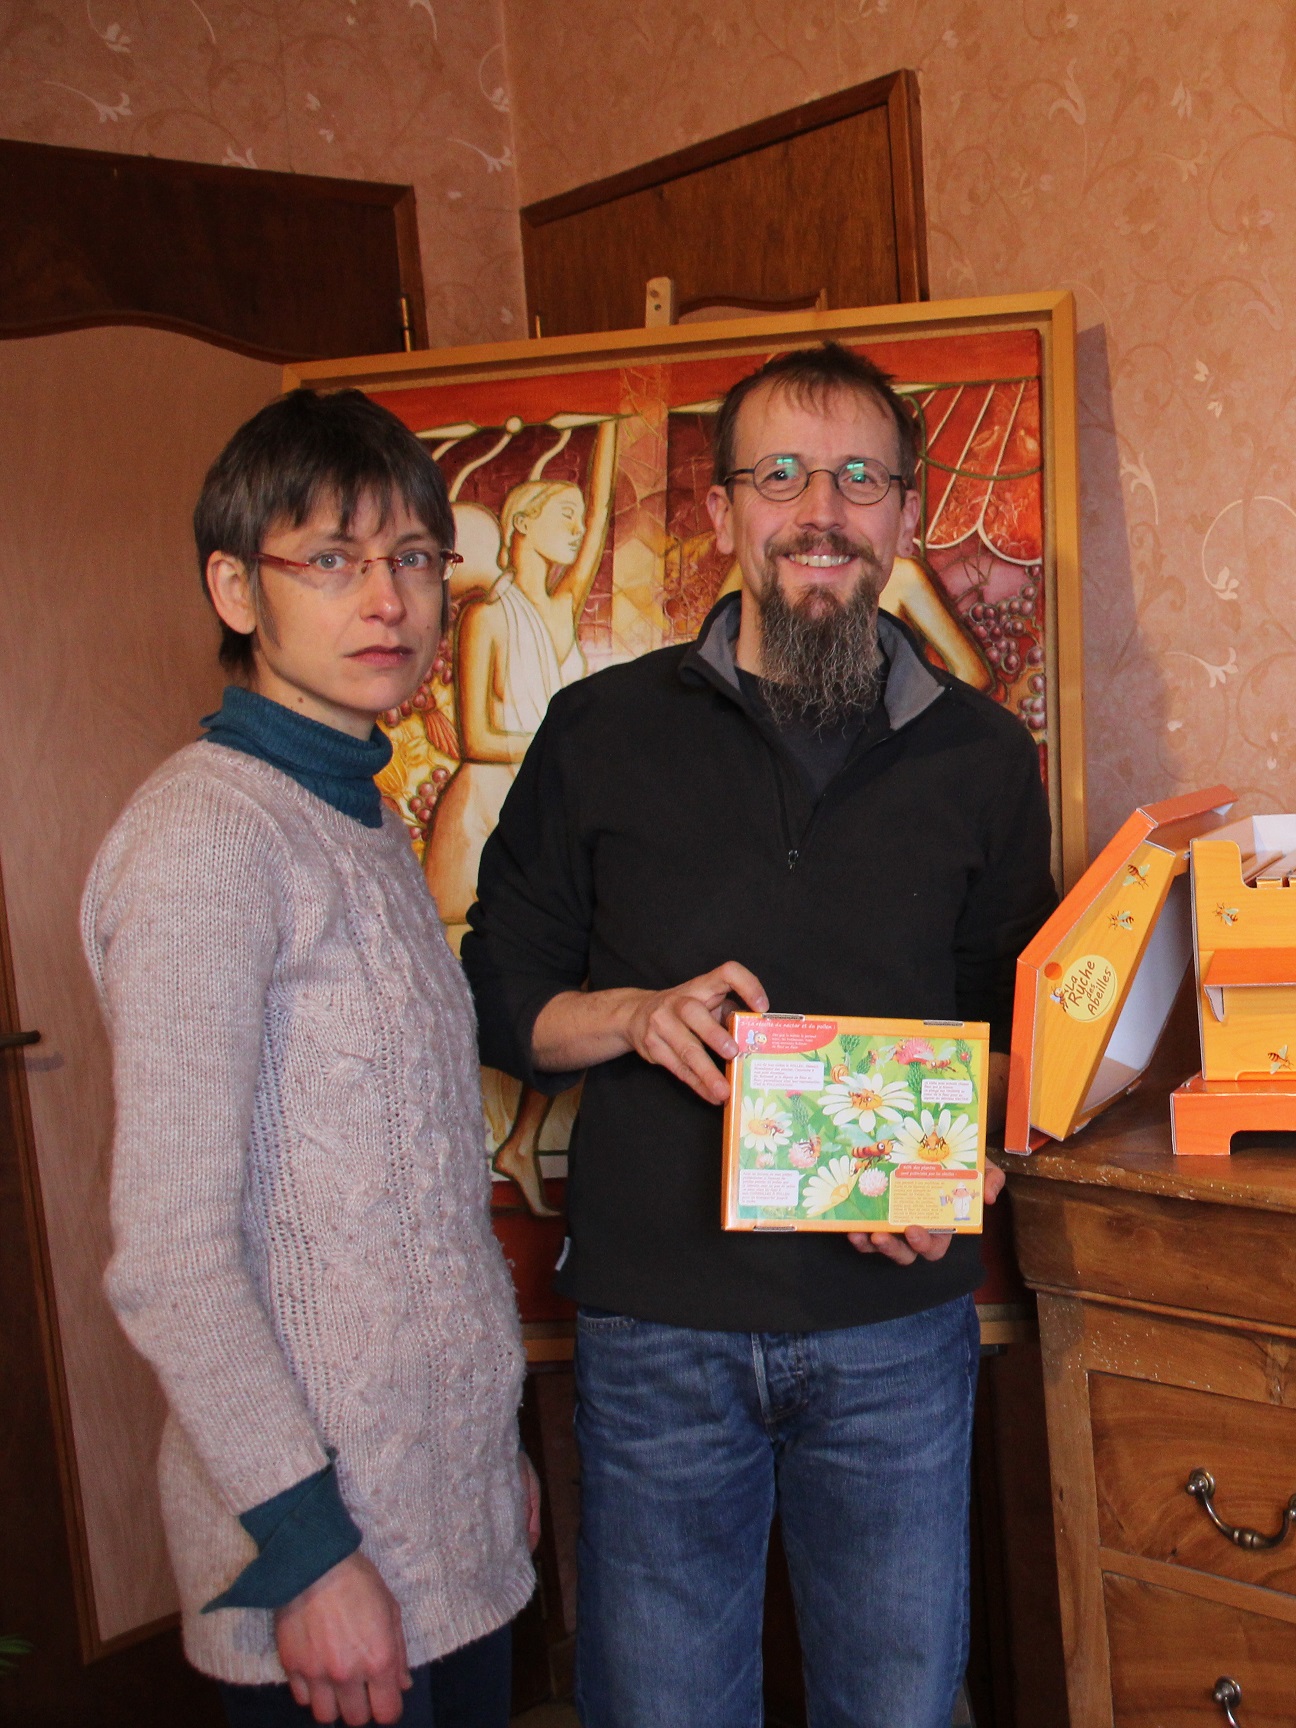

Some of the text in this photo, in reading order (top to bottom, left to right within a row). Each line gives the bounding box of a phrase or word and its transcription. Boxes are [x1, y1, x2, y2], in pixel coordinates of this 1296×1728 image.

[1065, 976, 1078, 991] La
[1068, 961, 1095, 1007] Ruche
[1086, 984, 1095, 999] des
[1088, 968, 1112, 1015] Abeilles
